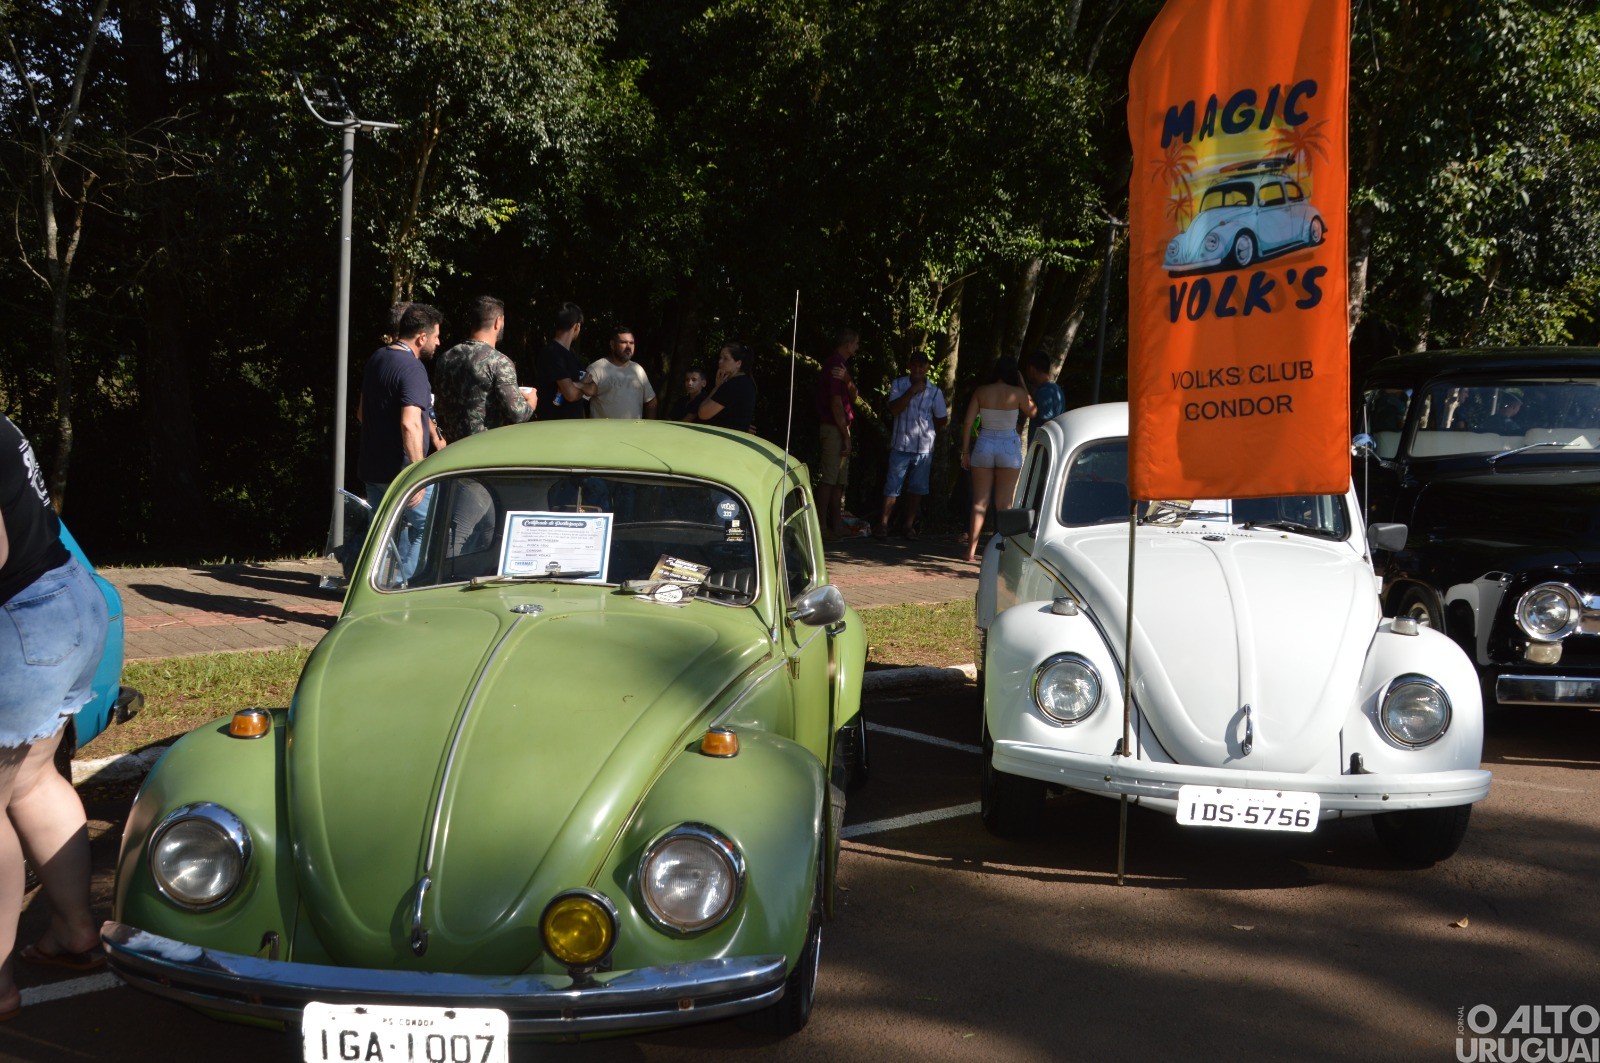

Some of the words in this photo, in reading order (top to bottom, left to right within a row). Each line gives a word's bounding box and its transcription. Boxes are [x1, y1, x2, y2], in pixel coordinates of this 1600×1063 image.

[1160, 79, 1318, 149] MAGIC
[1169, 265, 1327, 323] VOLK'S
[1171, 366, 1241, 391] VOLKS
[1249, 360, 1314, 384] CLUB
[1184, 394, 1293, 421] CONDOR
